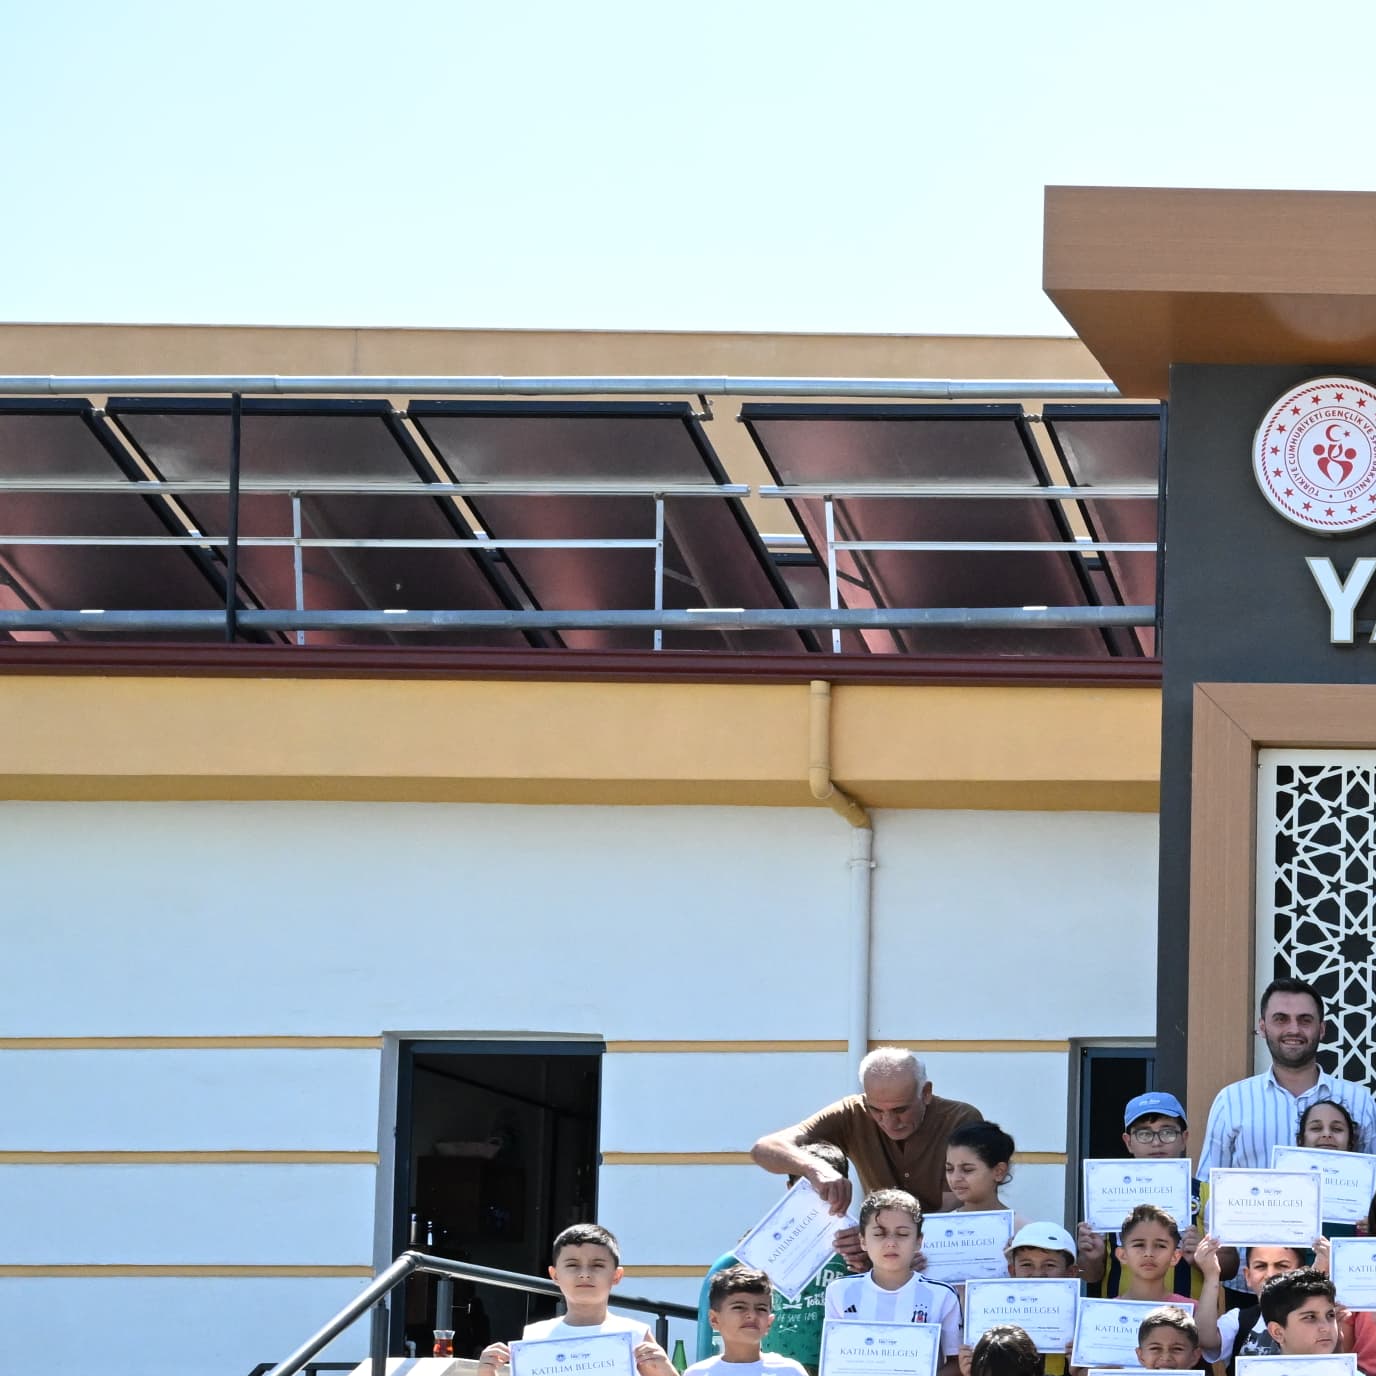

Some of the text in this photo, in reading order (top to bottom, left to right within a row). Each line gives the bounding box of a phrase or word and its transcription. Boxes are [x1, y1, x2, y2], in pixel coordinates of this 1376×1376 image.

[1325, 410, 1363, 425] GENÇLİK
[1364, 423, 1373, 434] VE
[1288, 411, 1324, 465] CUMHURİYETİ
[1290, 468, 1320, 497] TÜRKİYE
